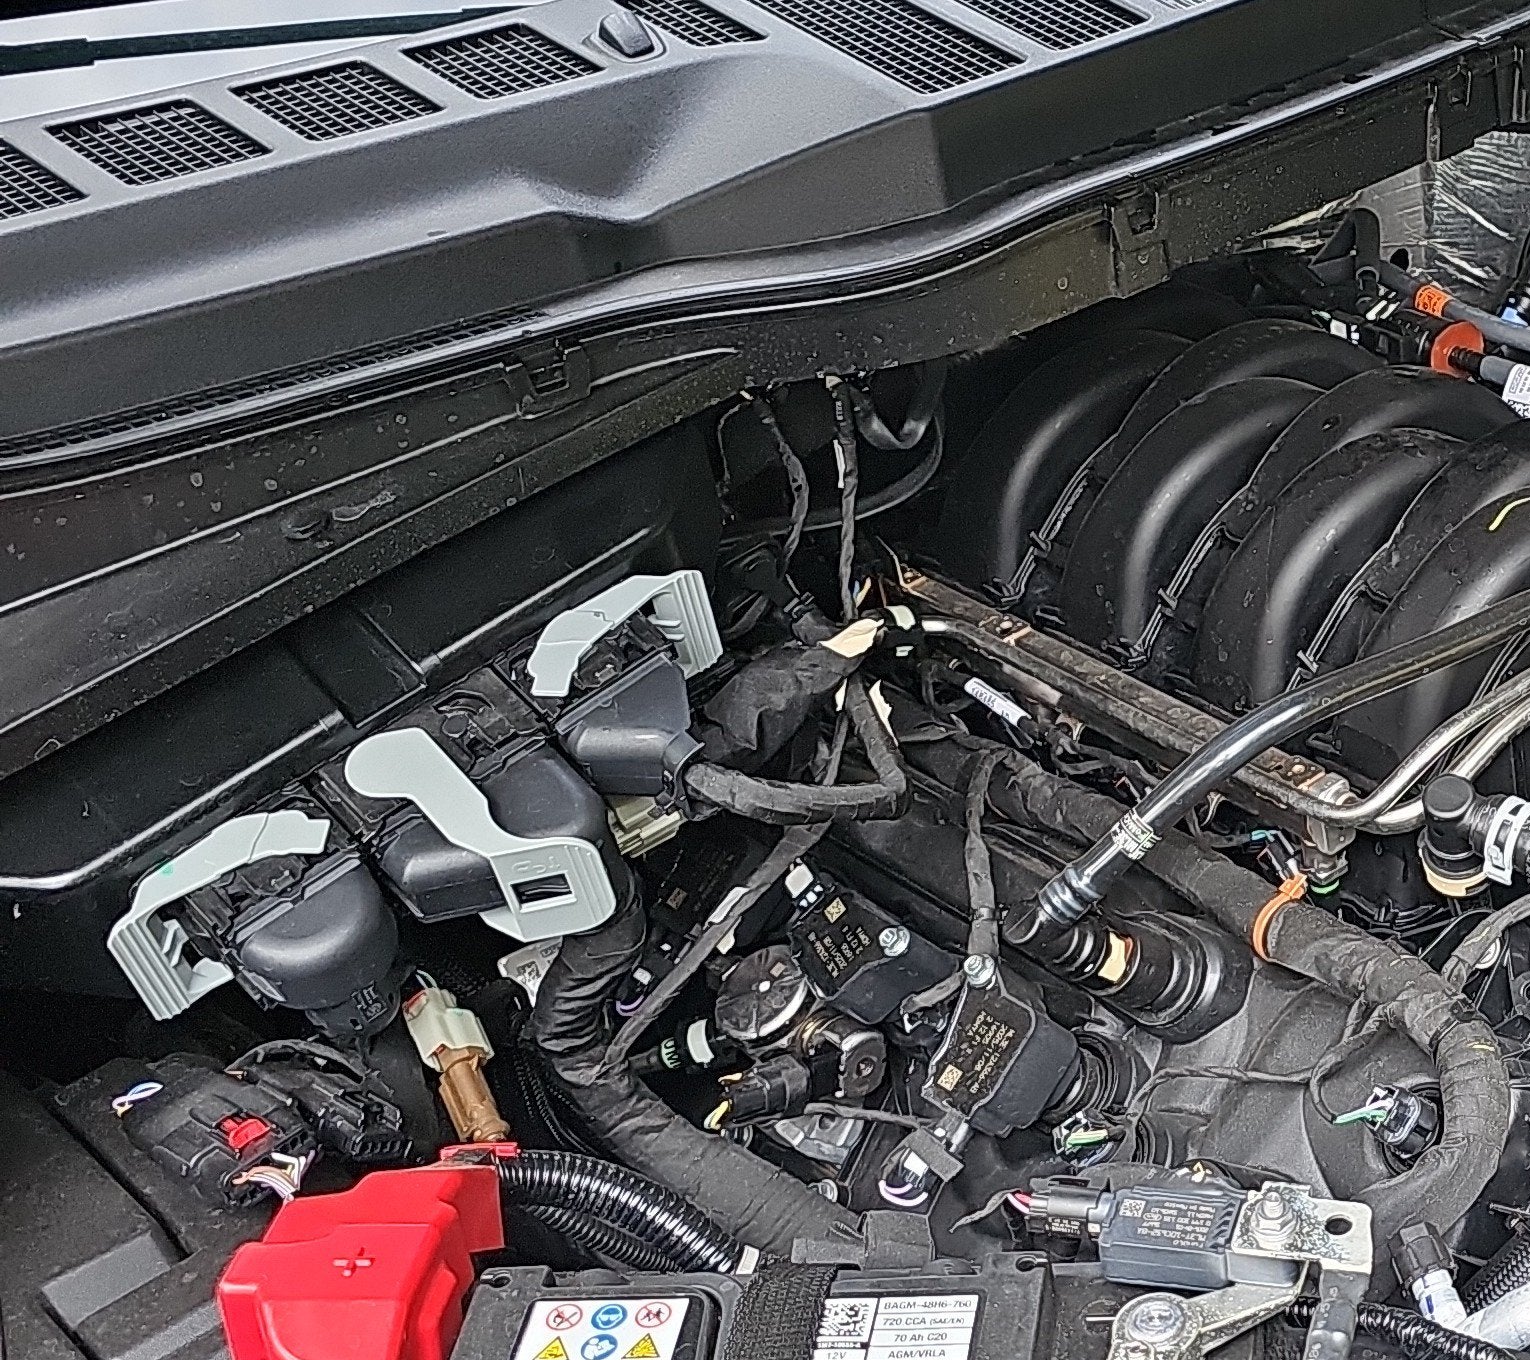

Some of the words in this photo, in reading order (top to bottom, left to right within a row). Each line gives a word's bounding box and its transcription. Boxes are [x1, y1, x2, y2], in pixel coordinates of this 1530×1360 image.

[884, 1300, 972, 1310] BAGM-48H6-760
[882, 1318, 903, 1326] 720
[894, 1334, 908, 1342] 70
[910, 1333, 924, 1342] Ah
[927, 1333, 948, 1341] C20
[827, 1352, 847, 1360] 12V
[888, 1349, 946, 1359] AGM/VRLA
